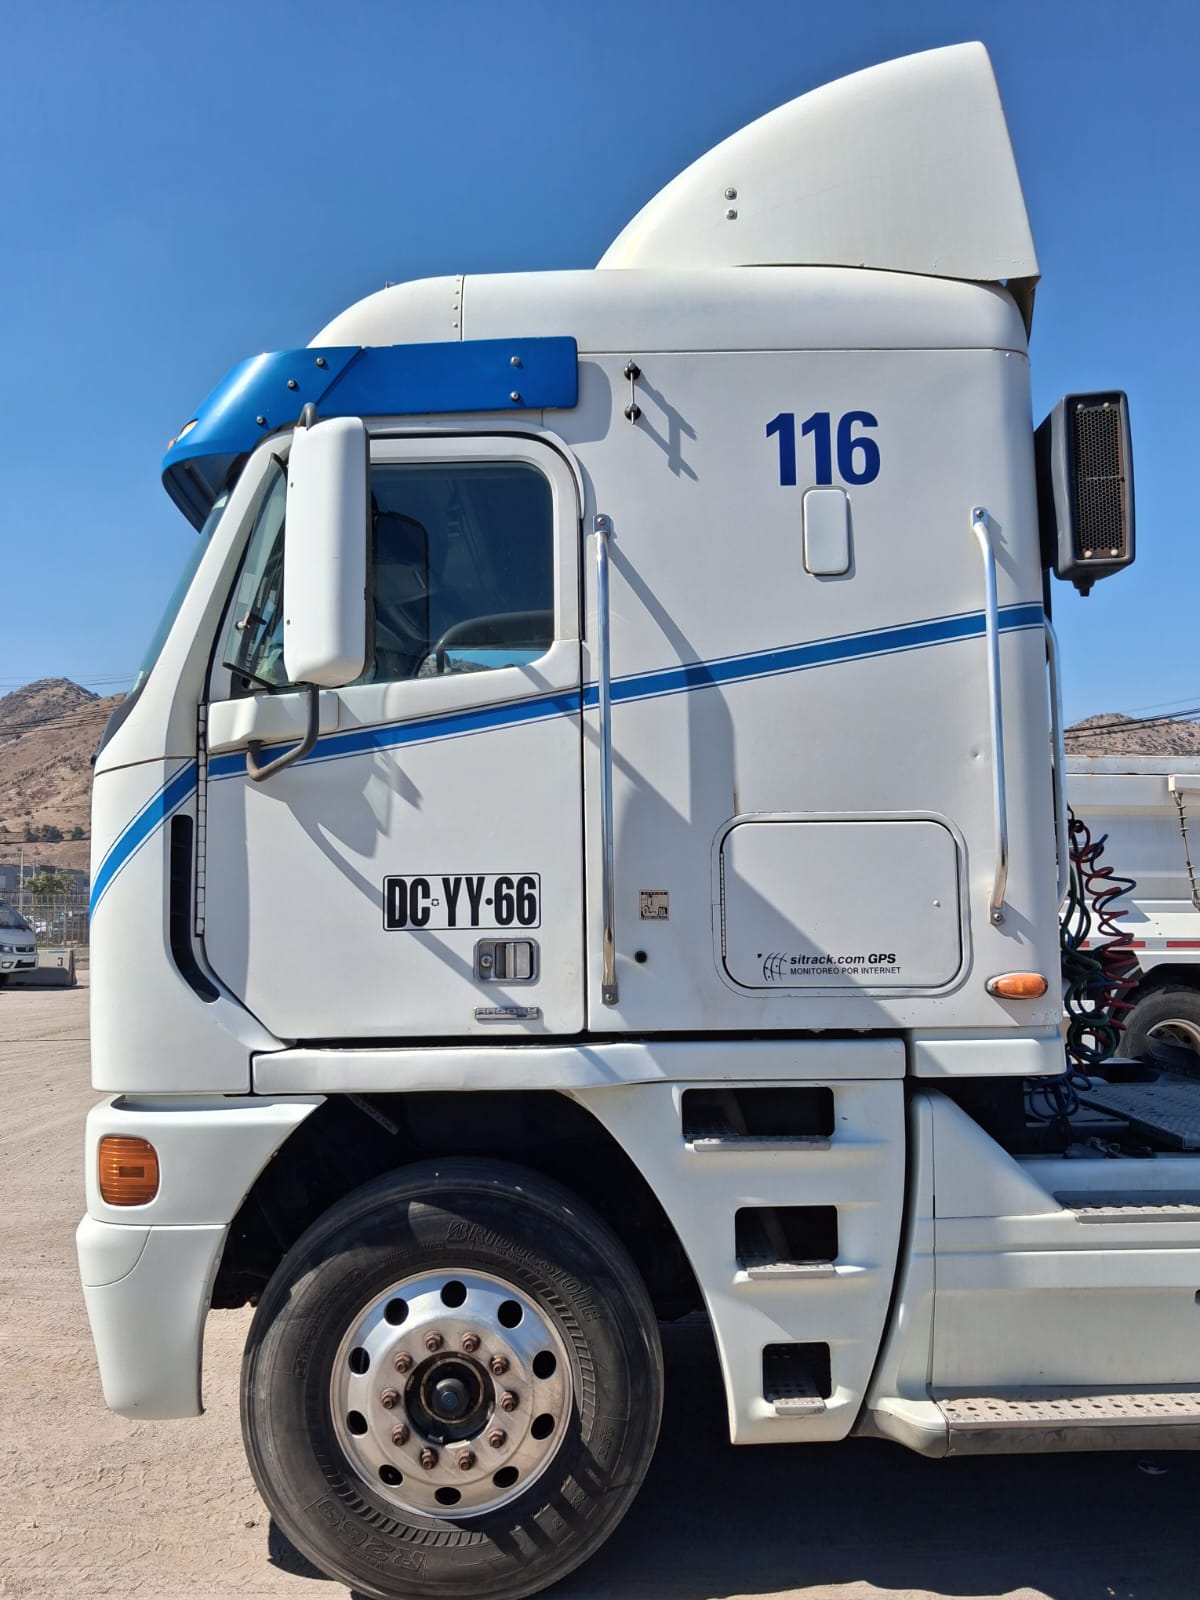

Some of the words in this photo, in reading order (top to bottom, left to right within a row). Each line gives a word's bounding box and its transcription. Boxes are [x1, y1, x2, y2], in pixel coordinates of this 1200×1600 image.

[766, 411, 880, 485] 116
[790, 954, 864, 964] sitrack.com
[868, 954, 896, 964] GPS
[790, 967, 839, 975] MONITOREO
[861, 966, 901, 974] INTERNET
